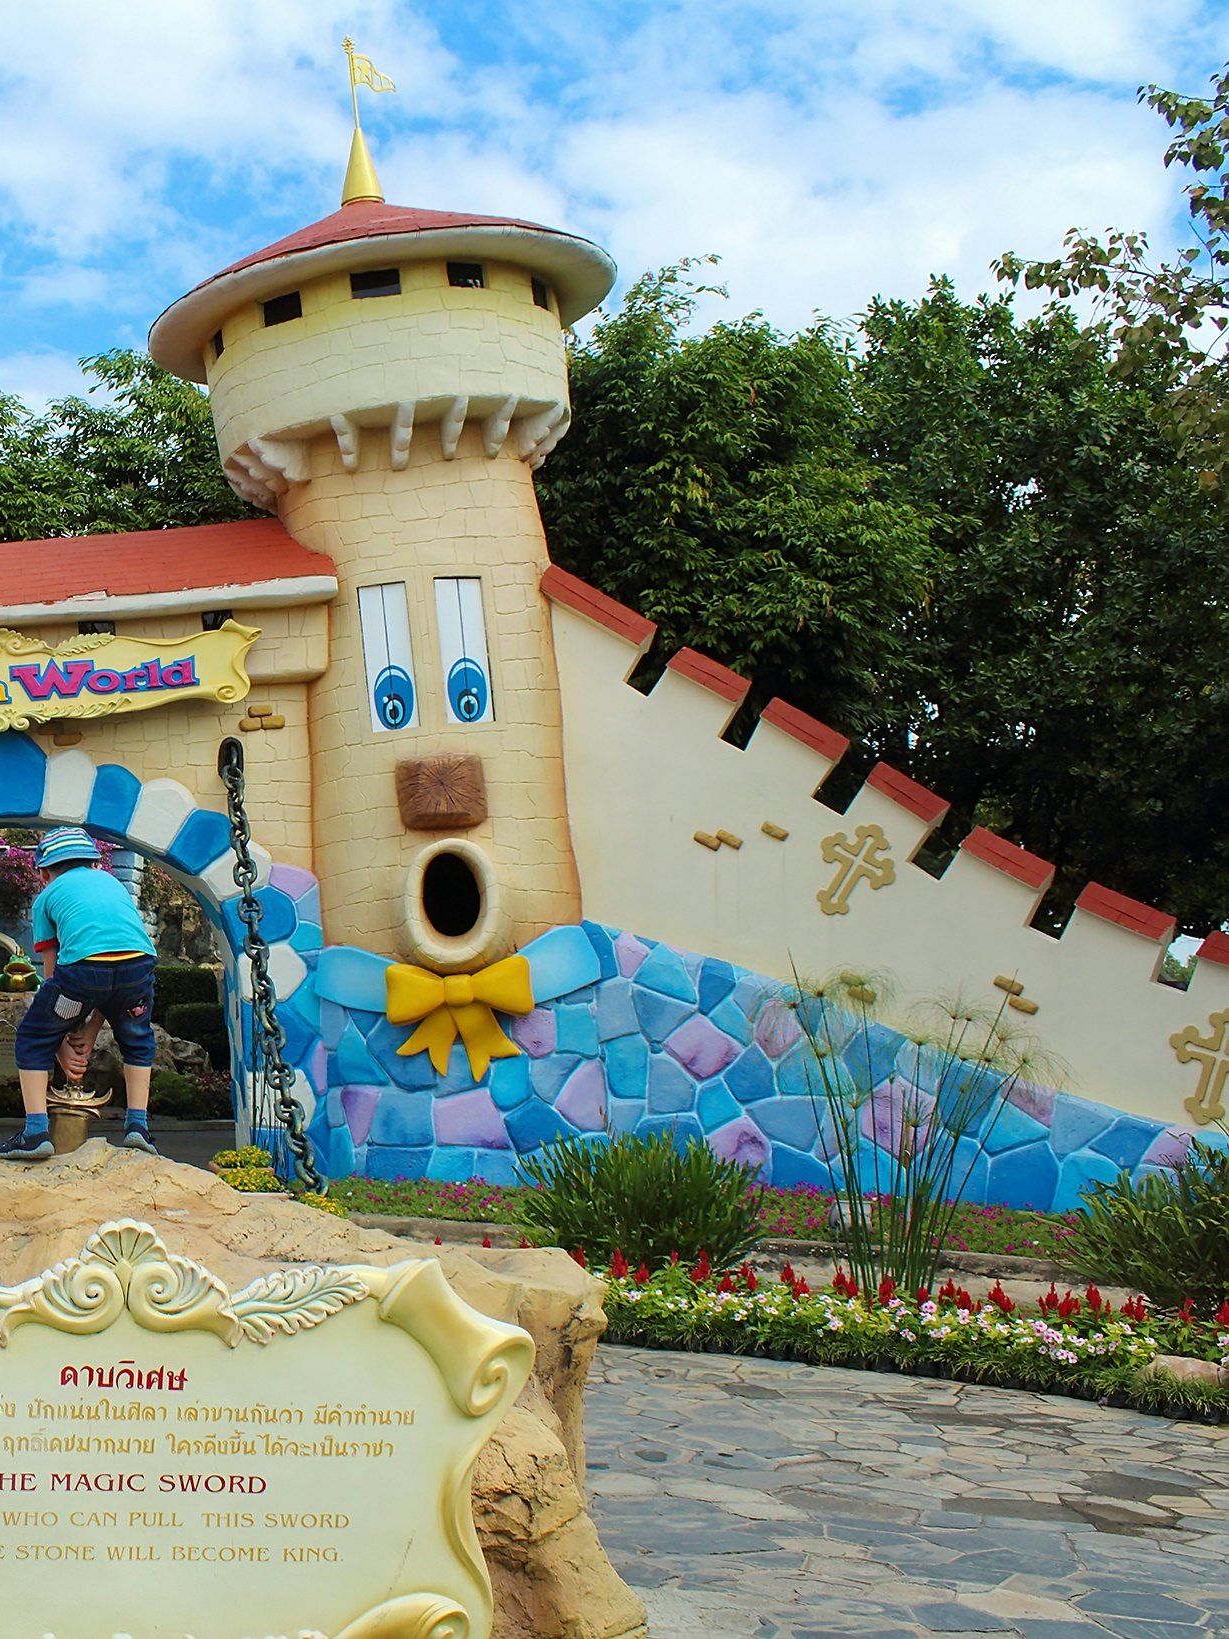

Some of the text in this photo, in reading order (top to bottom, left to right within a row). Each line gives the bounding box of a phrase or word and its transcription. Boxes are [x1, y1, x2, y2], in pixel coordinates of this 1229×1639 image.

[8, 654, 200, 701] World
[60, 1360, 189, 1391] ดาบวิเศษ
[27, 1398, 167, 1421] ปักแน่นในศิลา
[177, 1400, 303, 1425] เล่าขานกันว่า
[313, 1403, 415, 1427] มีคำทำนาย
[50, 1473, 147, 1493] MAGIC
[158, 1474, 268, 1494] SWORD
[1, 1511, 59, 1527] WHO
[69, 1511, 118, 1527] CAN
[129, 1511, 184, 1527] PULL
[201, 1512, 255, 1528] THIS
[264, 1513, 350, 1528] SWORD
[15, 1544, 96, 1561] STONE
[106, 1545, 161, 1561] WILL
[171, 1546, 270, 1562] BECOME
